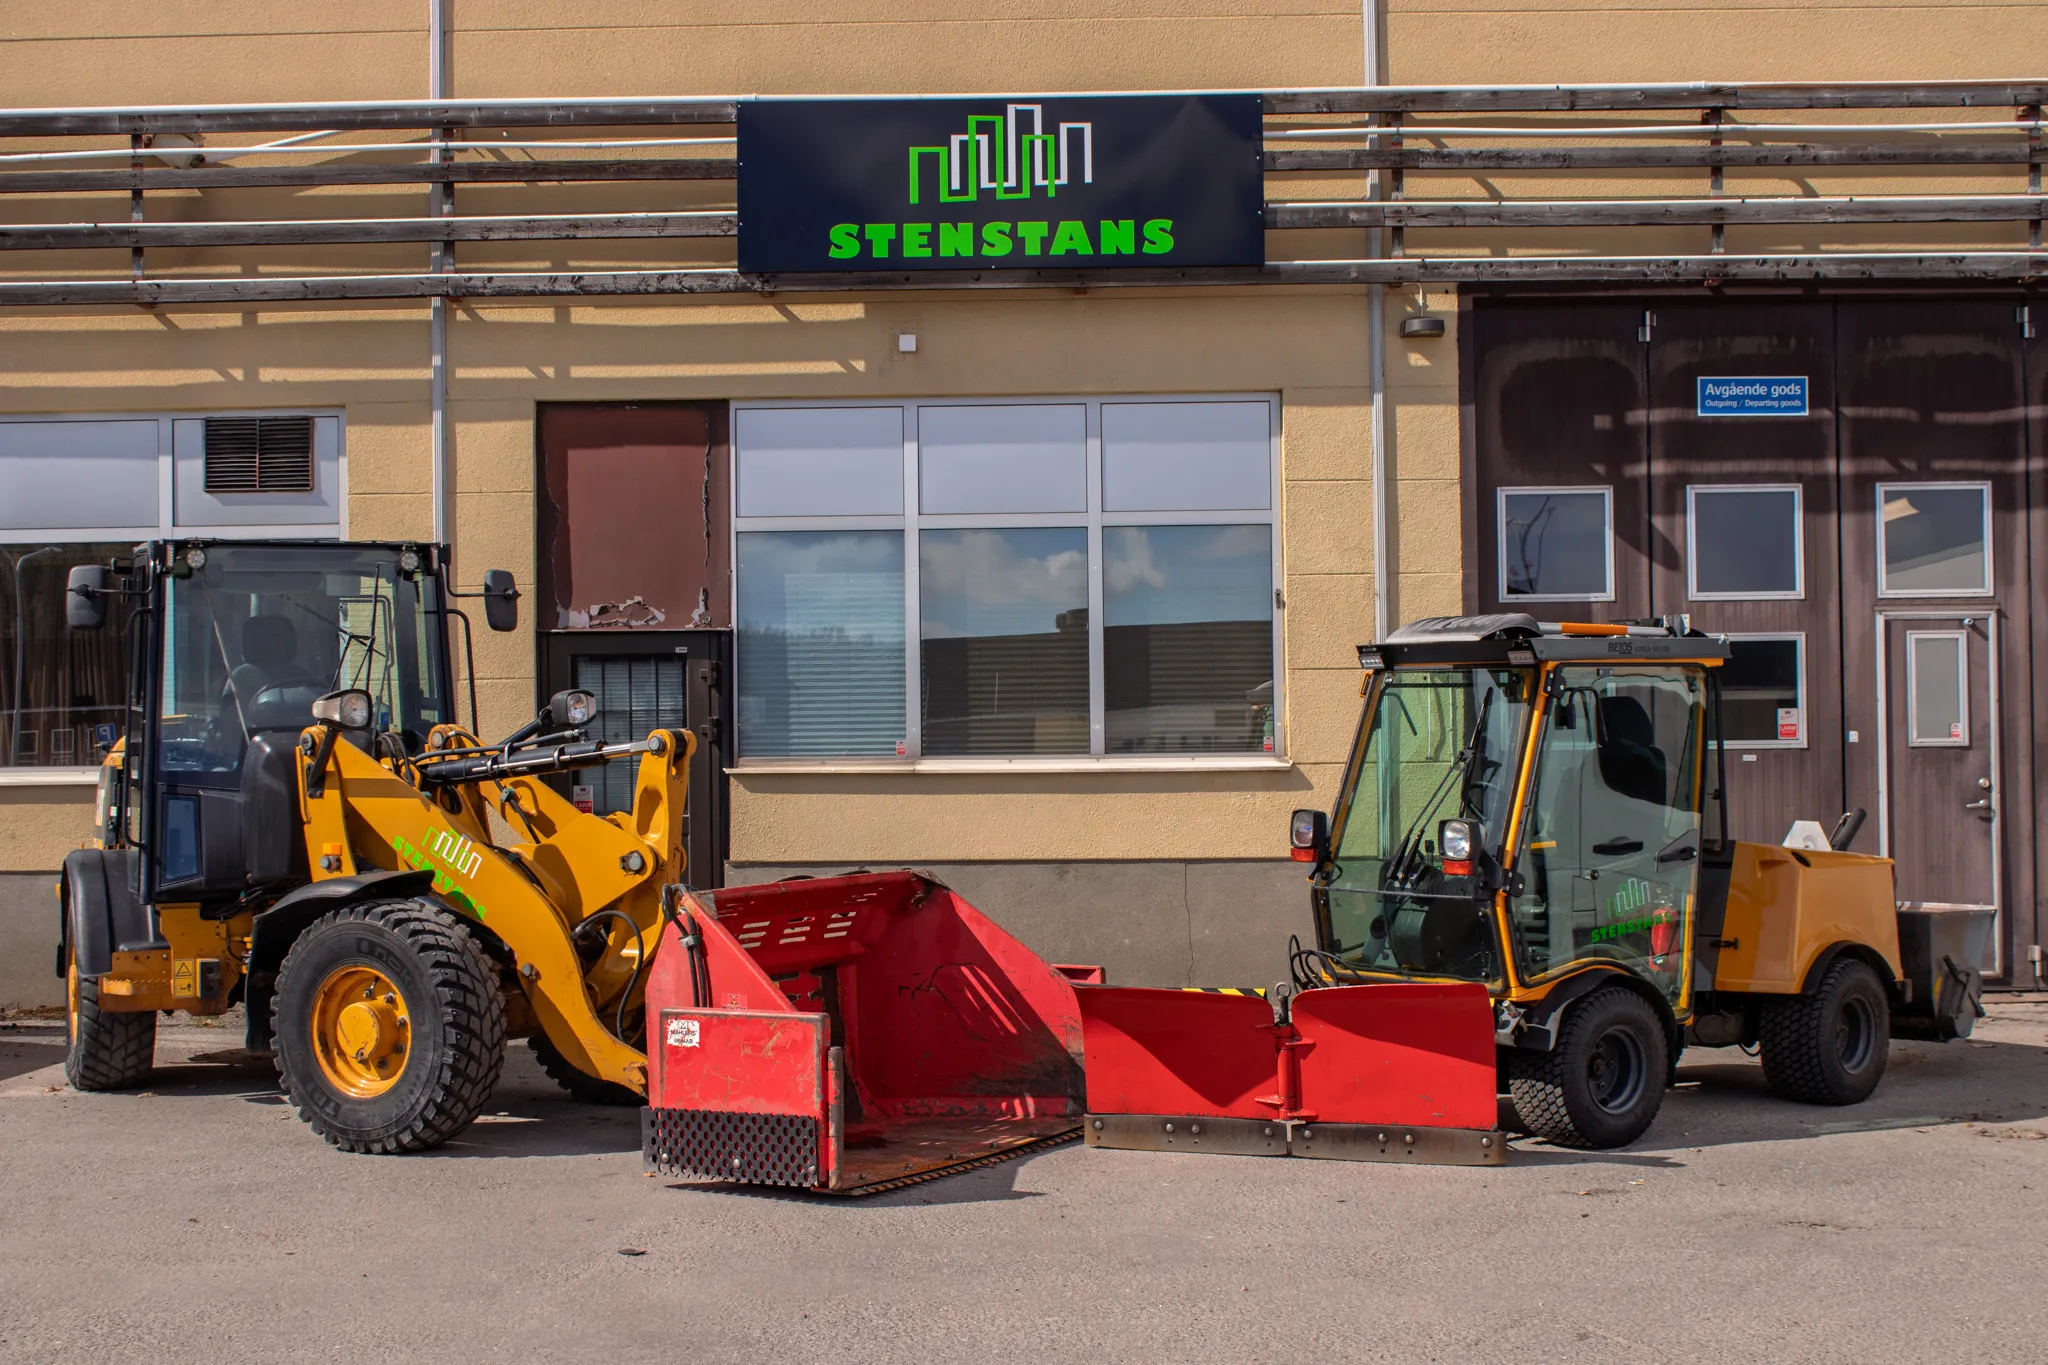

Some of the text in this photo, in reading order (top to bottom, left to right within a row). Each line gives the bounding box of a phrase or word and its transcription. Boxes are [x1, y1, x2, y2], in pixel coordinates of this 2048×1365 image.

[828, 219, 1174, 259] STENSTANS
[1705, 382, 1801, 398] Avgående gods
[1705, 399, 1737, 408] Outgoing
[1745, 399, 1778, 408] Departing
[1780, 400, 1801, 408] goods
[1608, 642, 1633, 655] BELOS
[1591, 911, 1672, 943] STENSTANS
